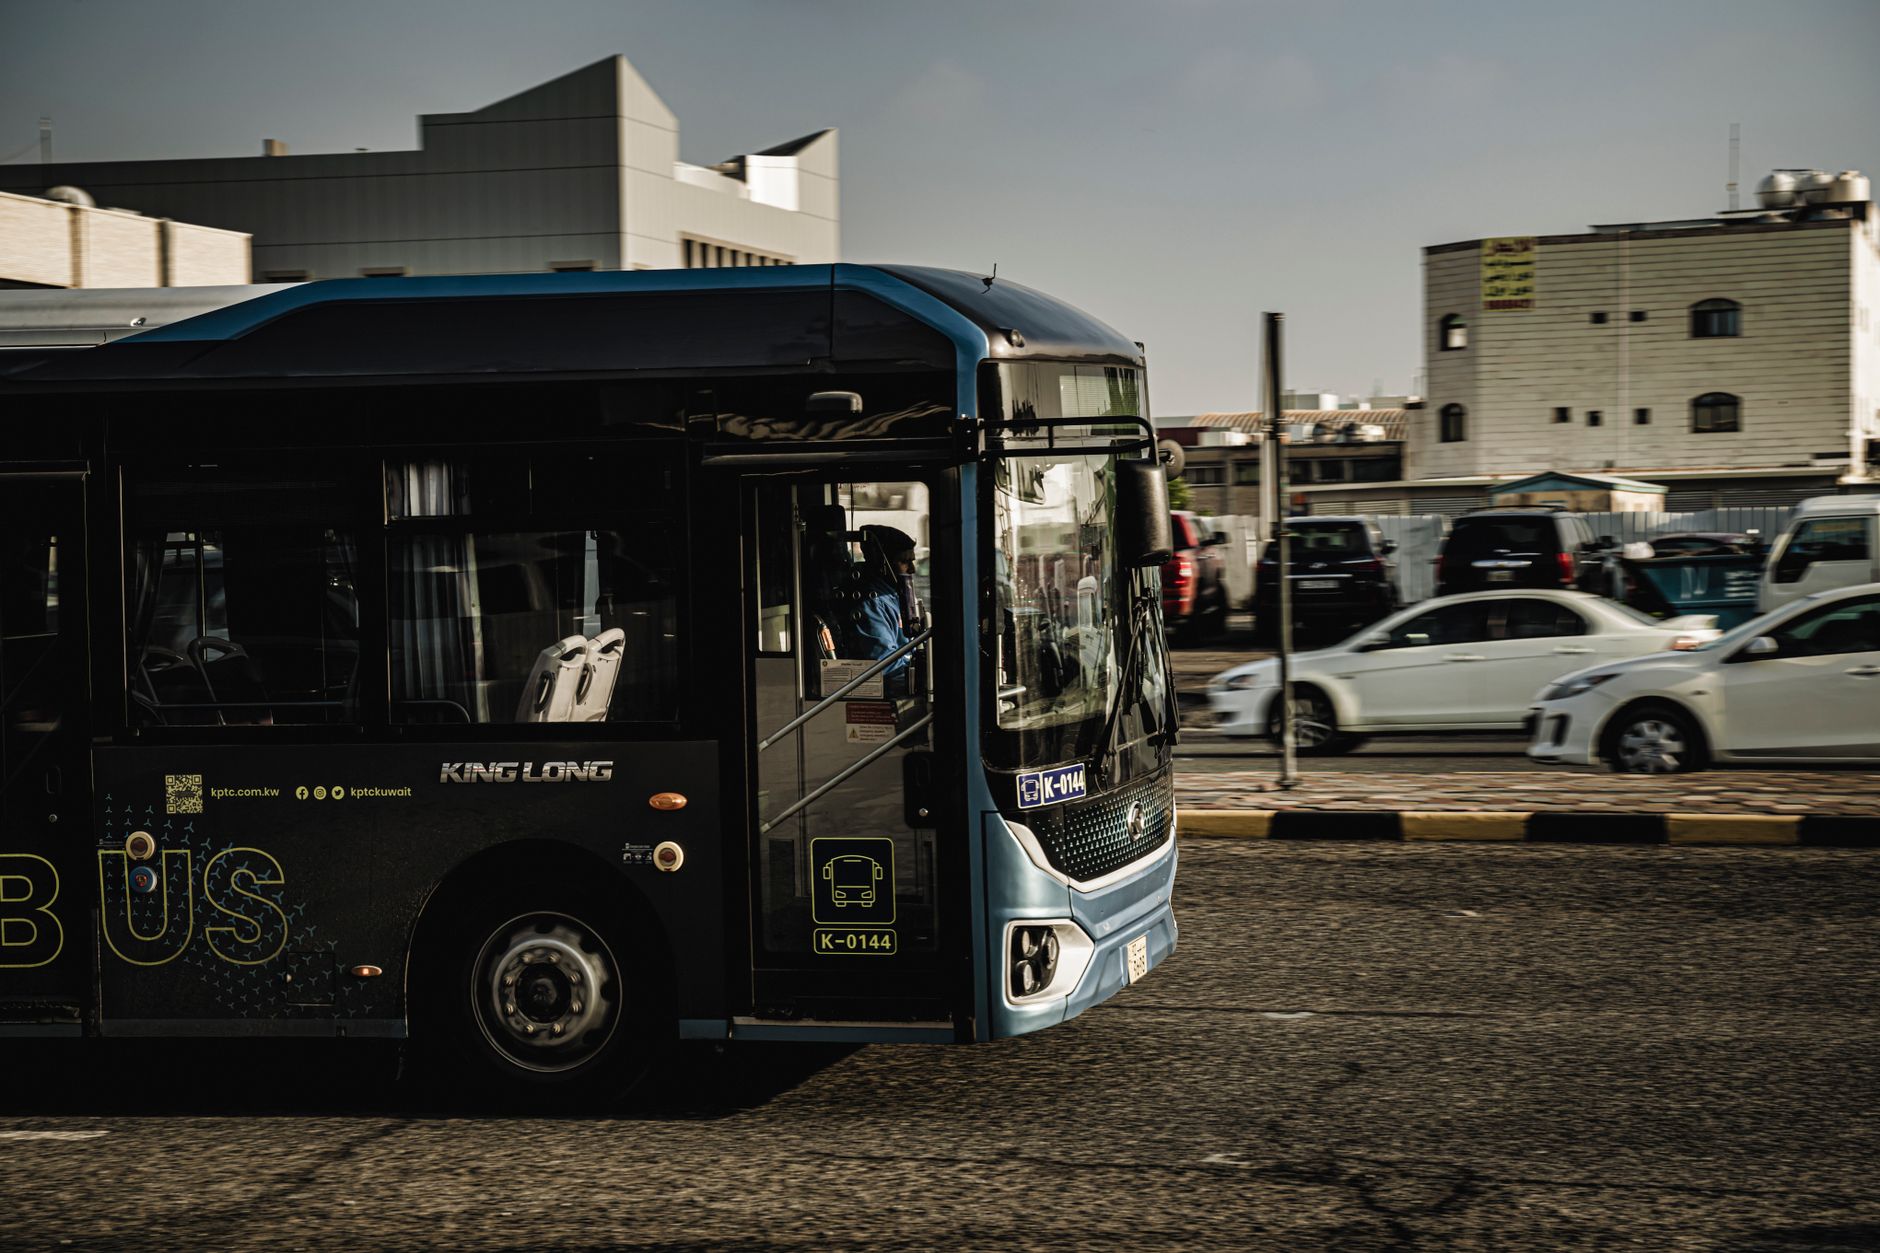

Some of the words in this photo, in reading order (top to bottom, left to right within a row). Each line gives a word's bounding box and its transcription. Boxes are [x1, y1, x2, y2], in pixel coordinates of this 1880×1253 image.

[440, 761, 519, 784] KING
[522, 760, 614, 783] LONG
[210, 786, 280, 800] kptc.com.kw
[350, 786, 412, 800] kptckuwait
[1044, 770, 1084, 799] K-0144
[821, 933, 892, 950] K-0144
